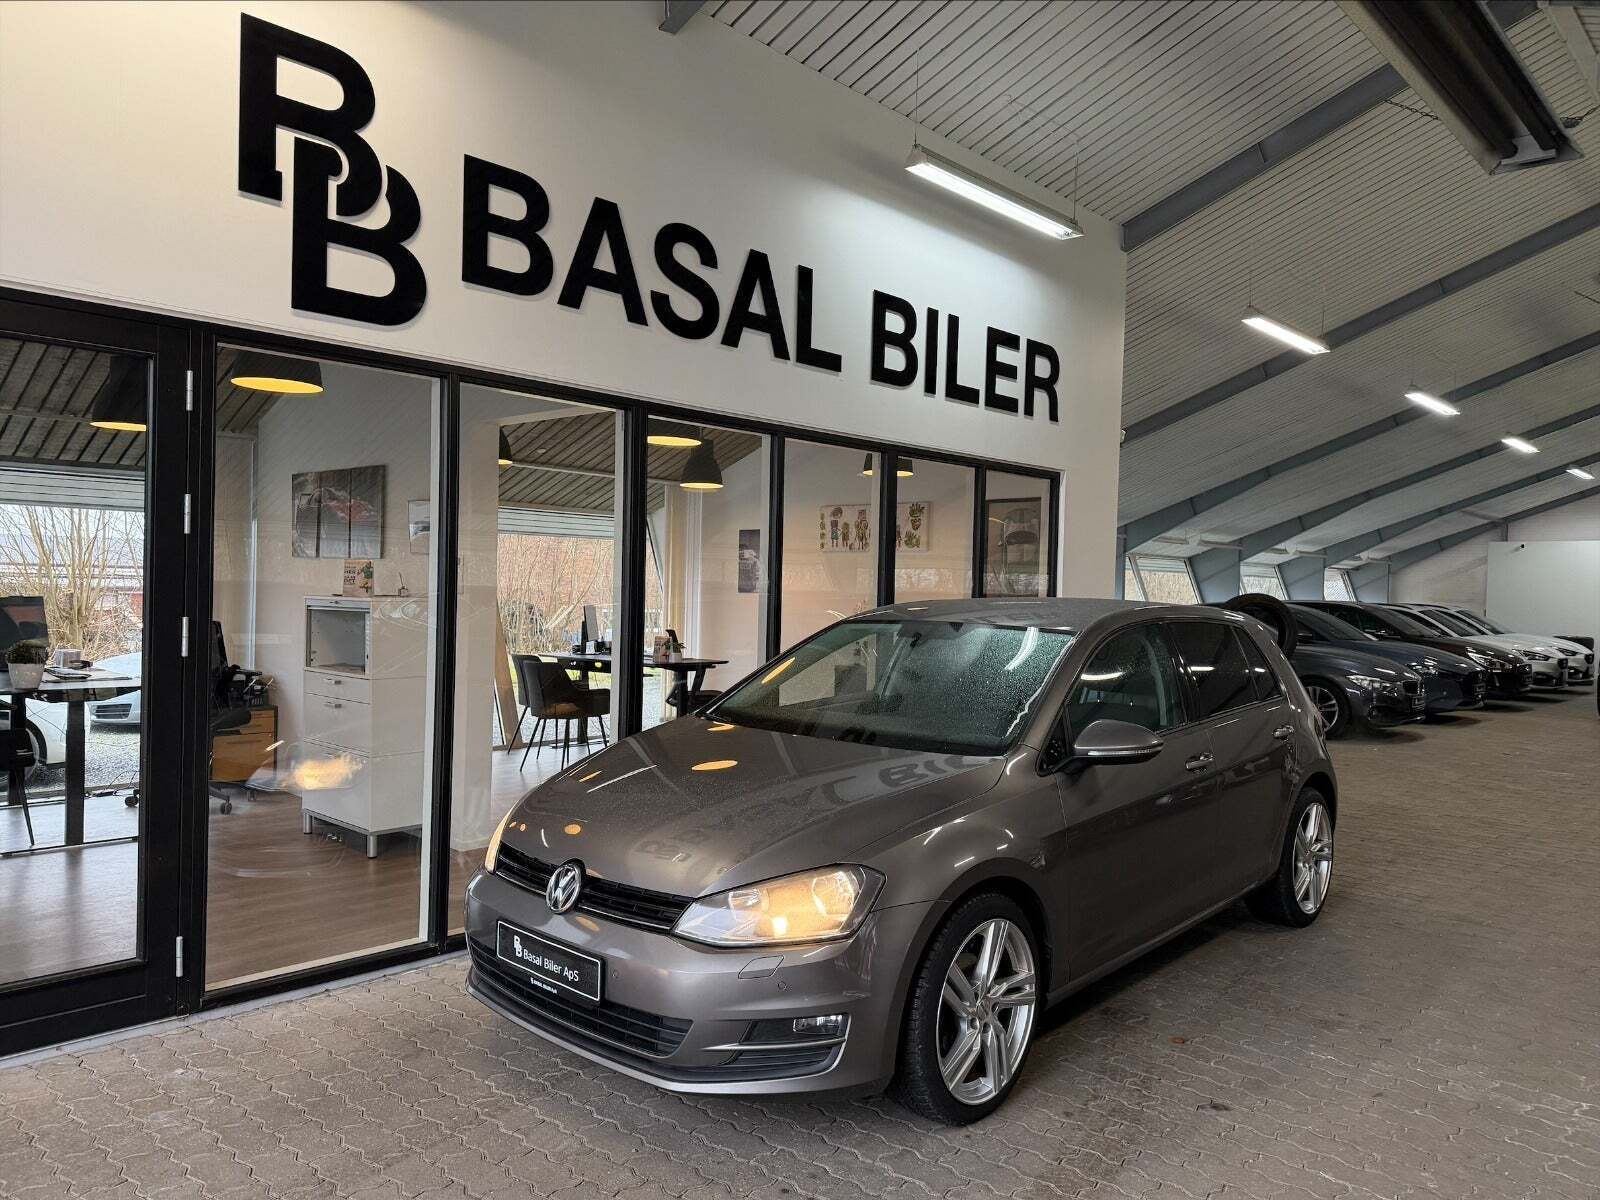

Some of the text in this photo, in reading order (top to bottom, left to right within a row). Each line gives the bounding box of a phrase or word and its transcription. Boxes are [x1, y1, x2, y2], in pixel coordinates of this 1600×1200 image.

[461, 154, 842, 373] BASAL
[871, 289, 1061, 423] BILER
[523, 949, 543, 967] Basal
[544, 958, 563, 975] Biler
[563, 966, 580, 982] ApS
